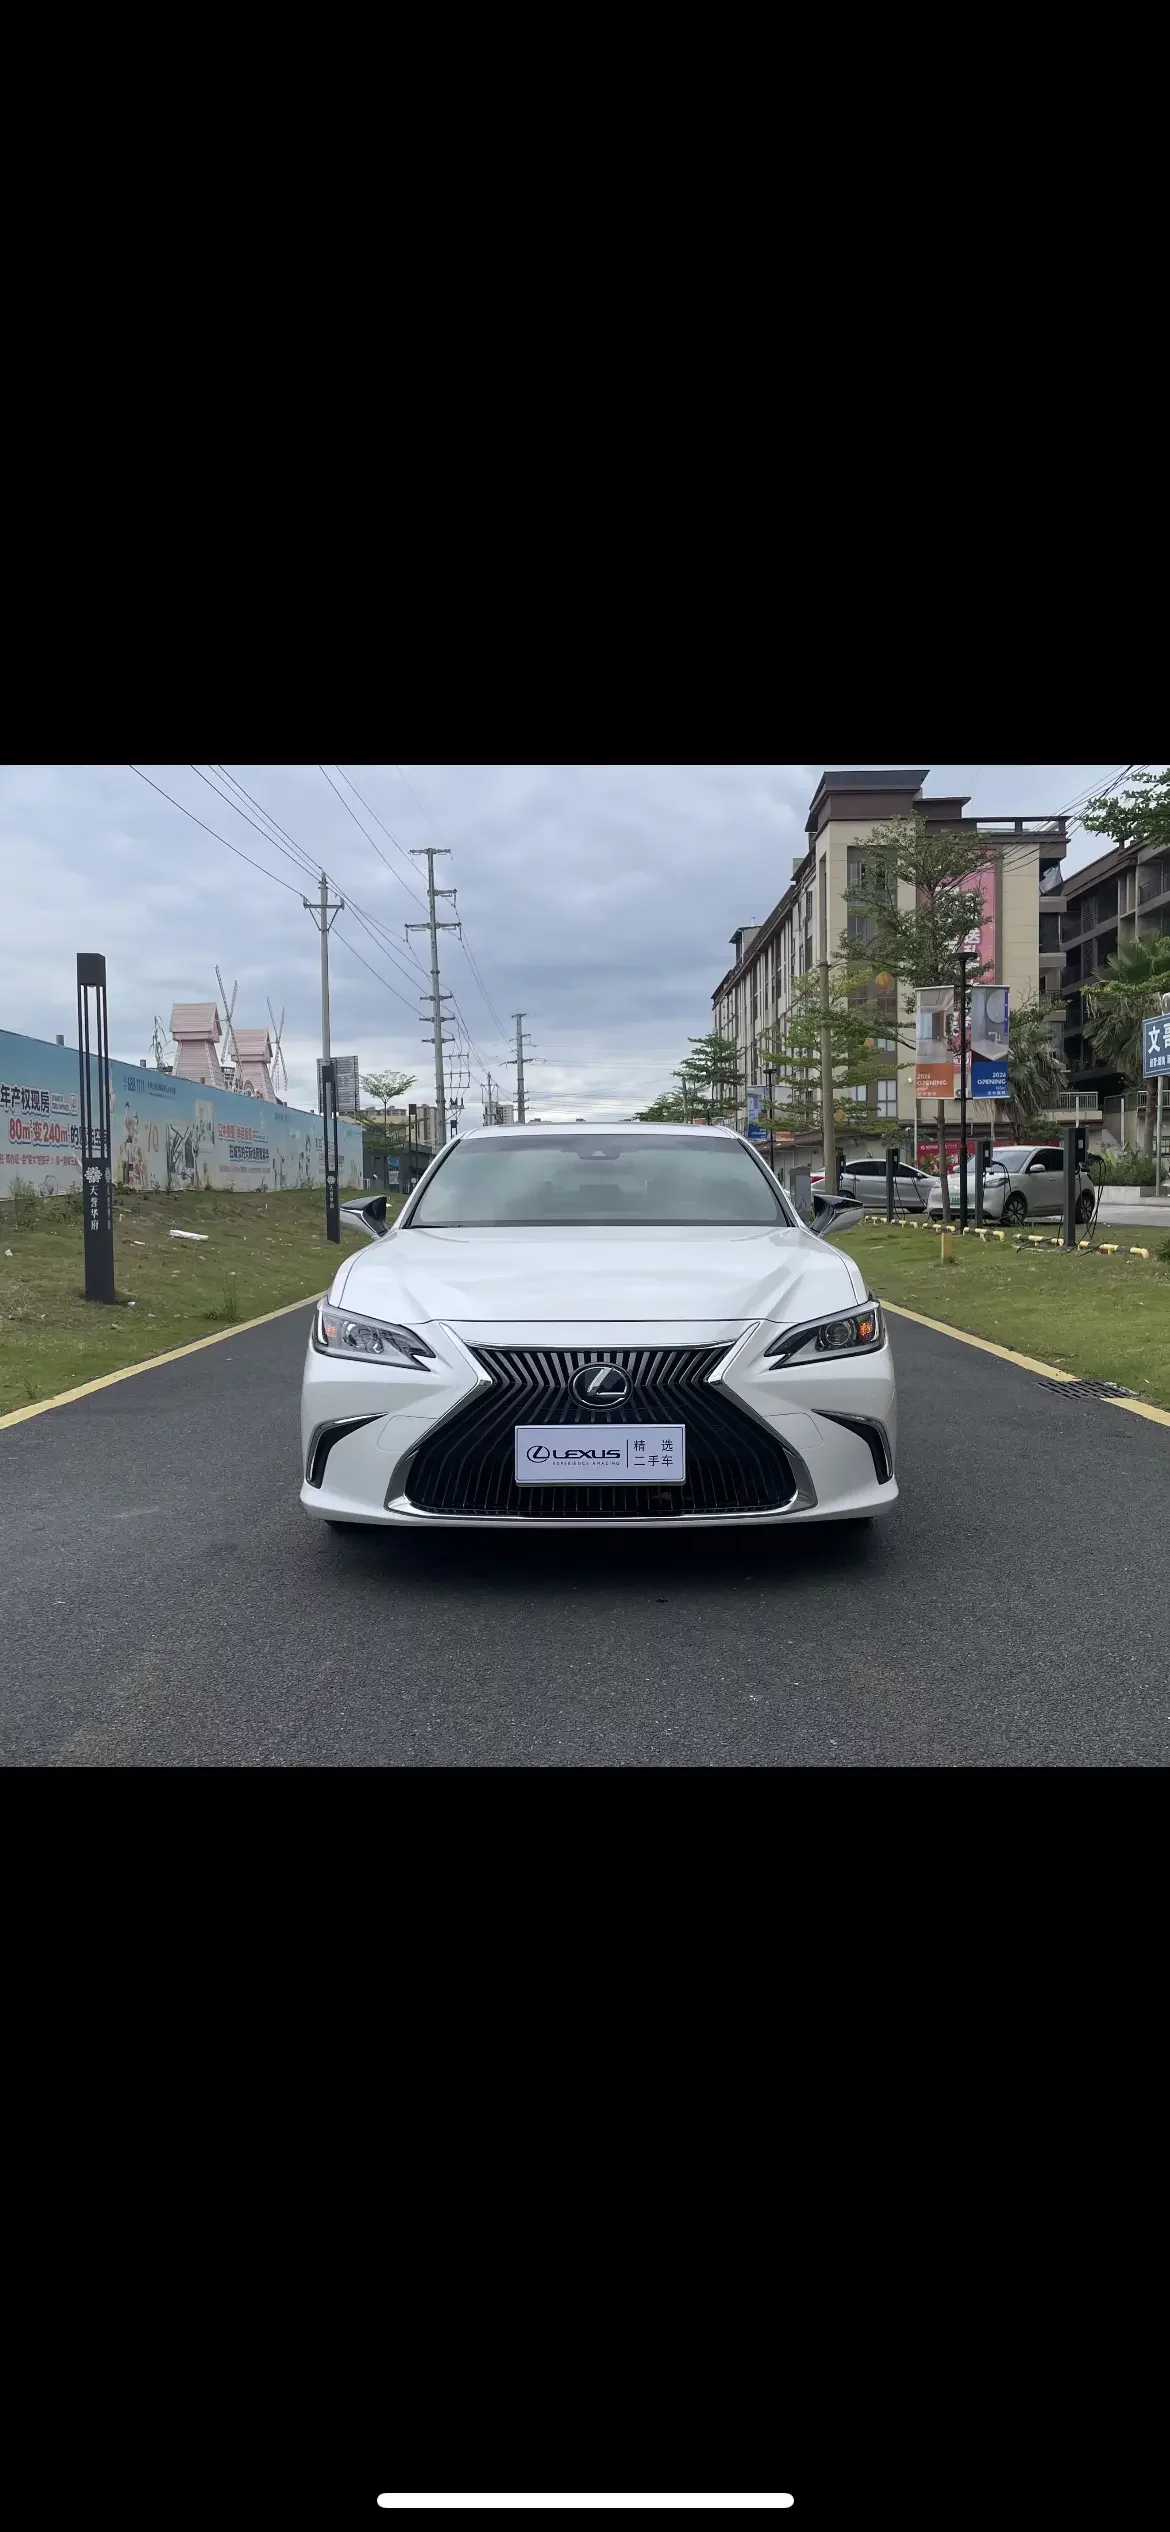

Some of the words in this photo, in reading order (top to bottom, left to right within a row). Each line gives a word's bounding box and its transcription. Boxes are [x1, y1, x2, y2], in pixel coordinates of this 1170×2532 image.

[552, 1449, 621, 1459] LEXUS
[633, 1455, 674, 1467] 二手车
